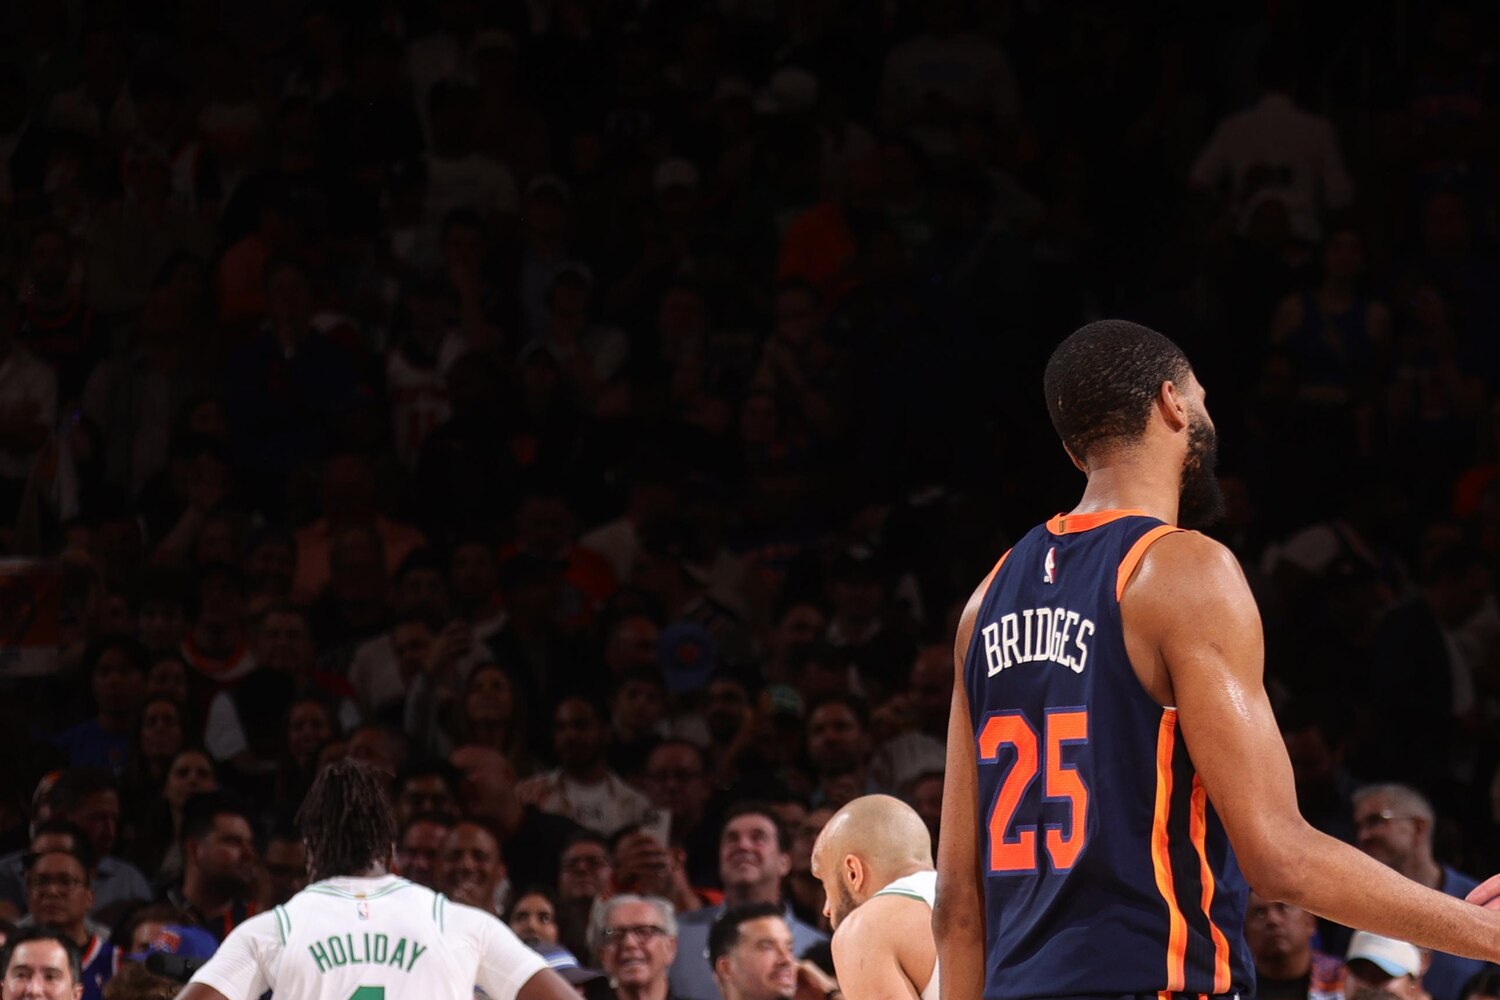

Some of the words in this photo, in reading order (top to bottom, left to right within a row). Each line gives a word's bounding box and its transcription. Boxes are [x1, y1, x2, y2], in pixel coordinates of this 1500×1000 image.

[981, 607, 1096, 679] BRIDGES
[977, 707, 1089, 873] 25
[309, 935, 427, 973] HOLIDAY
